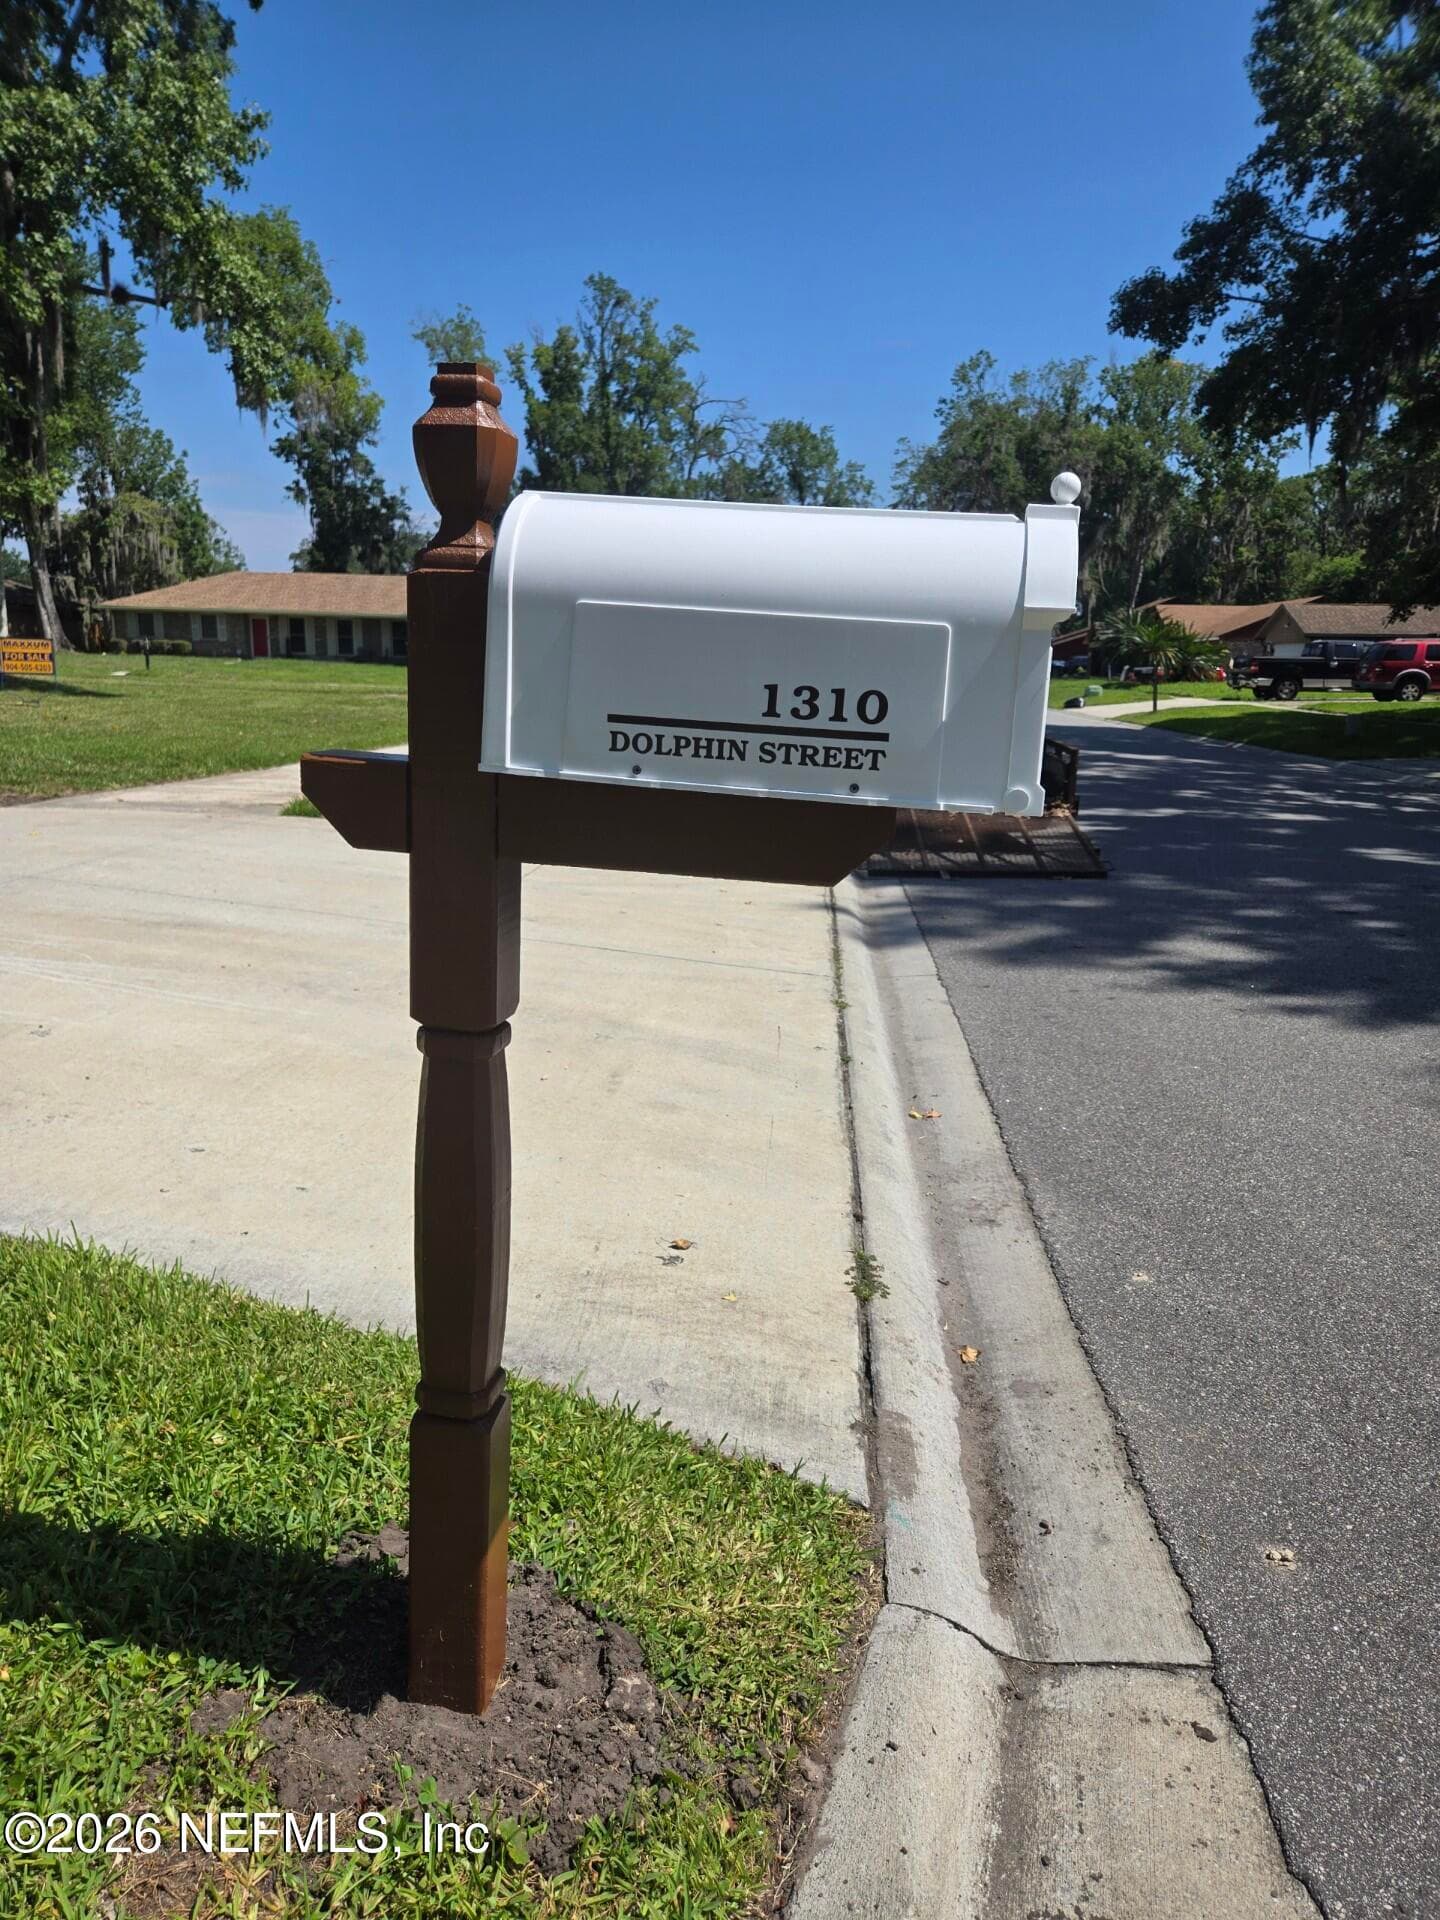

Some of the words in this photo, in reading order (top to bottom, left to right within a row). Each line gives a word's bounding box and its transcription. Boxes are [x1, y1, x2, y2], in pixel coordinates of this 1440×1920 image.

[3, 640, 49, 649] MAXXUM
[5, 653, 24, 661] FOR
[27, 653, 50, 662] SALE
[761, 683, 889, 725] 1310
[608, 730, 749, 762] DOLPHIN
[758, 741, 887, 771] STREET
